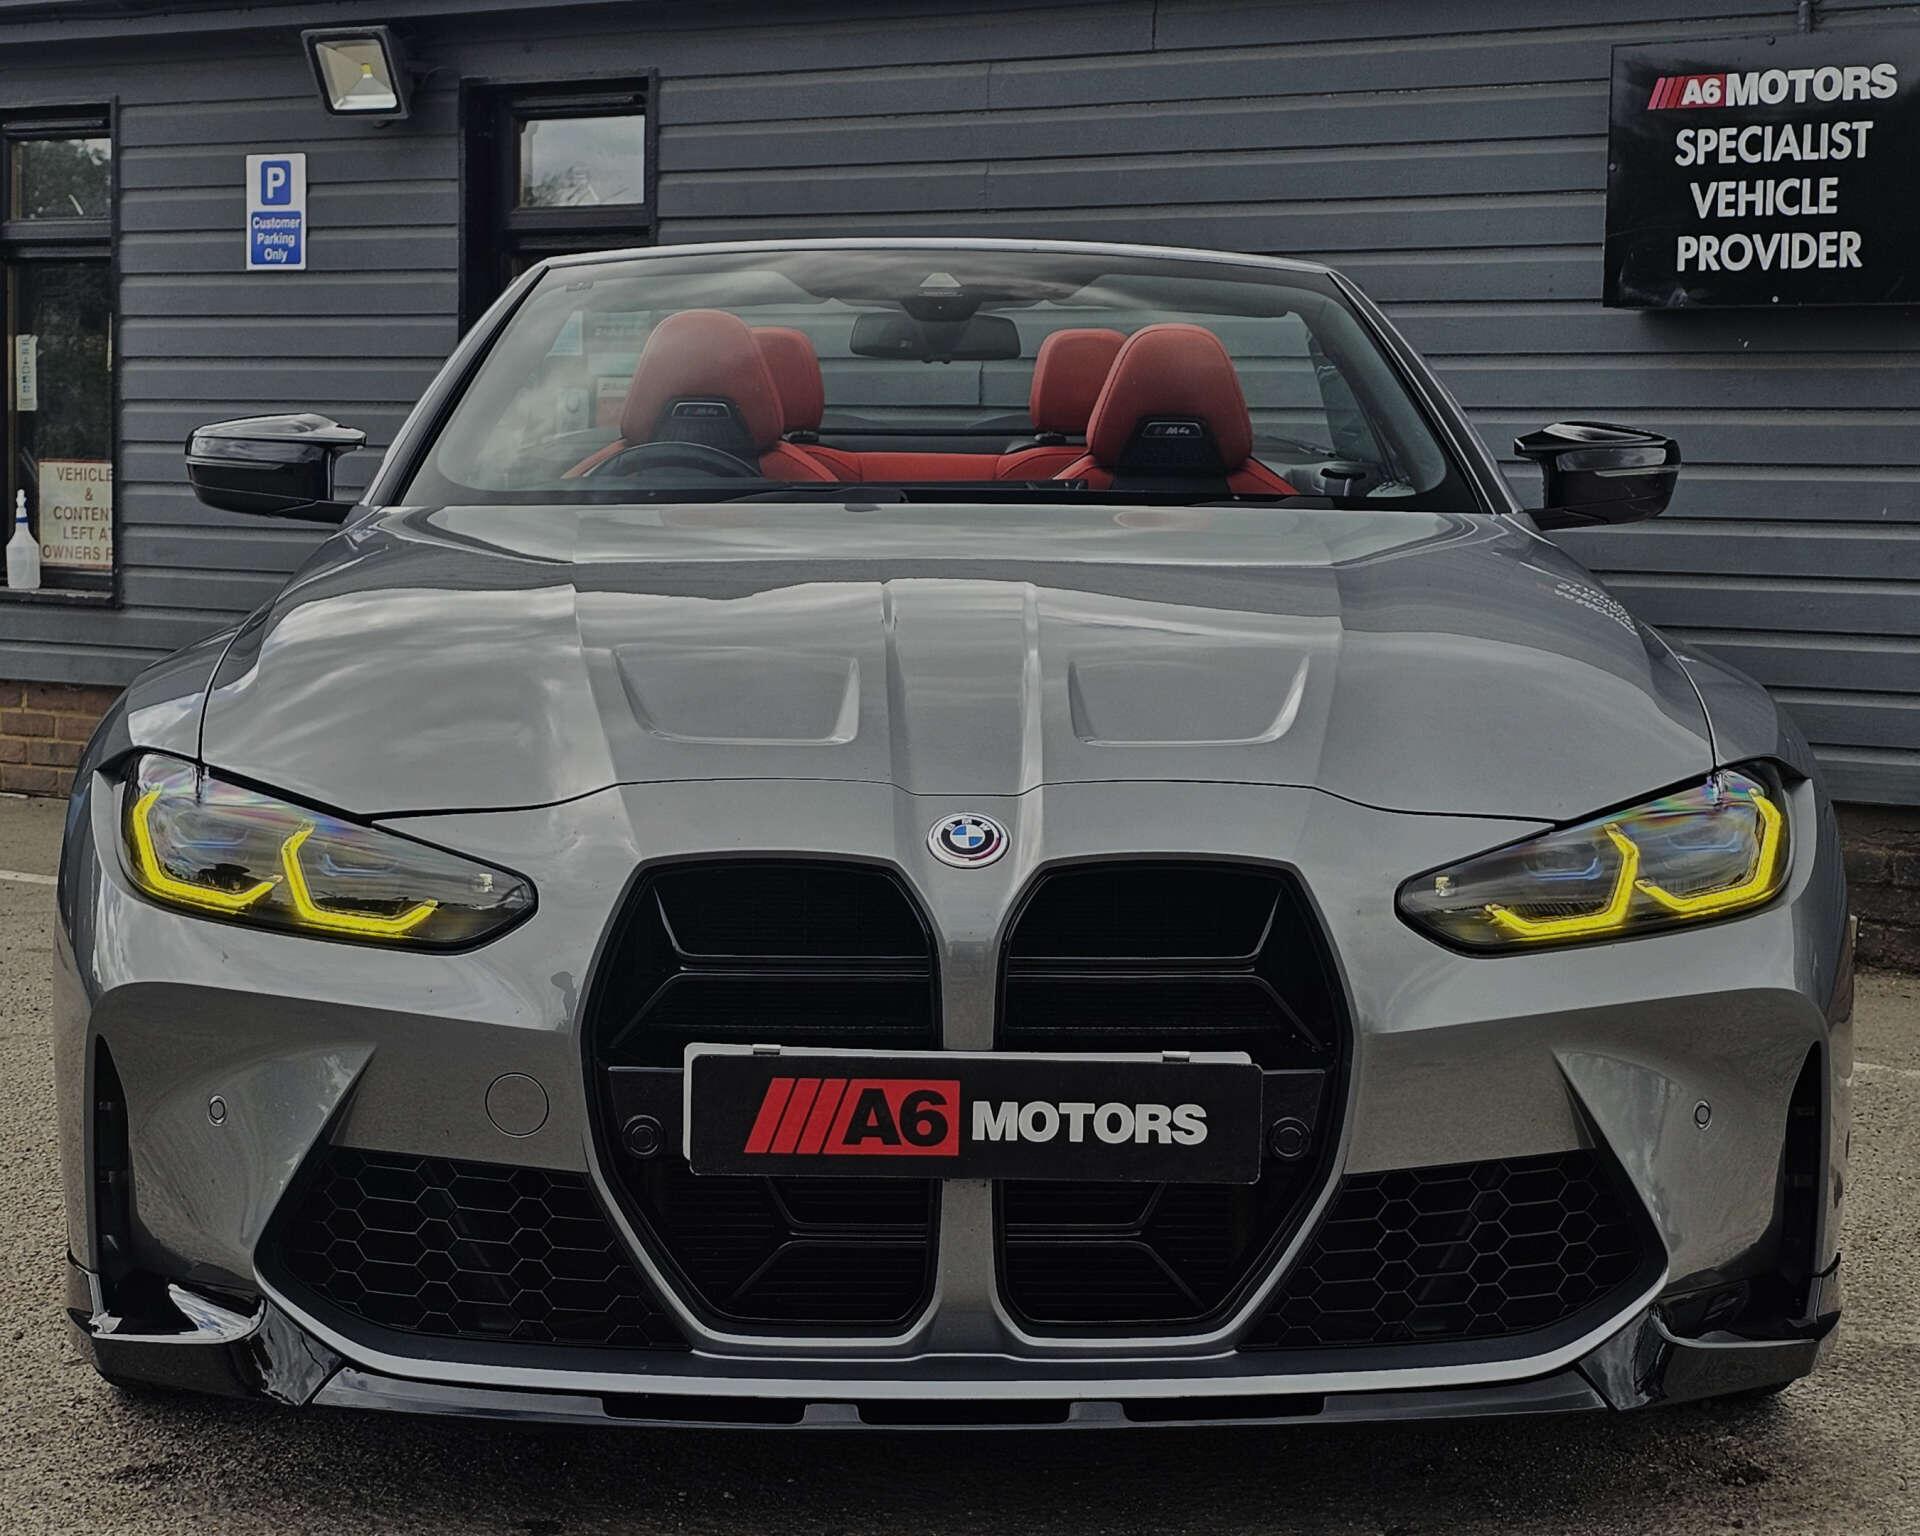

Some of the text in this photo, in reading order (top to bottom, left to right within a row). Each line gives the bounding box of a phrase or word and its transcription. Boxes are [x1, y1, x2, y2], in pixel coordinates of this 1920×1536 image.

[1681, 63, 1898, 107] A6 MOTORS
[1674, 120, 1874, 167] SPECIALIST
[266, 167, 286, 199] P
[1690, 177, 1839, 219] VEHICLE
[252, 216, 301, 229] Customer
[256, 232, 296, 247] Parking
[264, 247, 288, 263] Only
[1676, 230, 1863, 272] PROVIDER
[84, 487, 93, 501] &
[53, 505, 112, 521] CONTEN
[63, 526, 95, 540] LEFT
[42, 544, 101, 561] OWNERS
[841, 1087, 1208, 1147] A6 MOTORS
